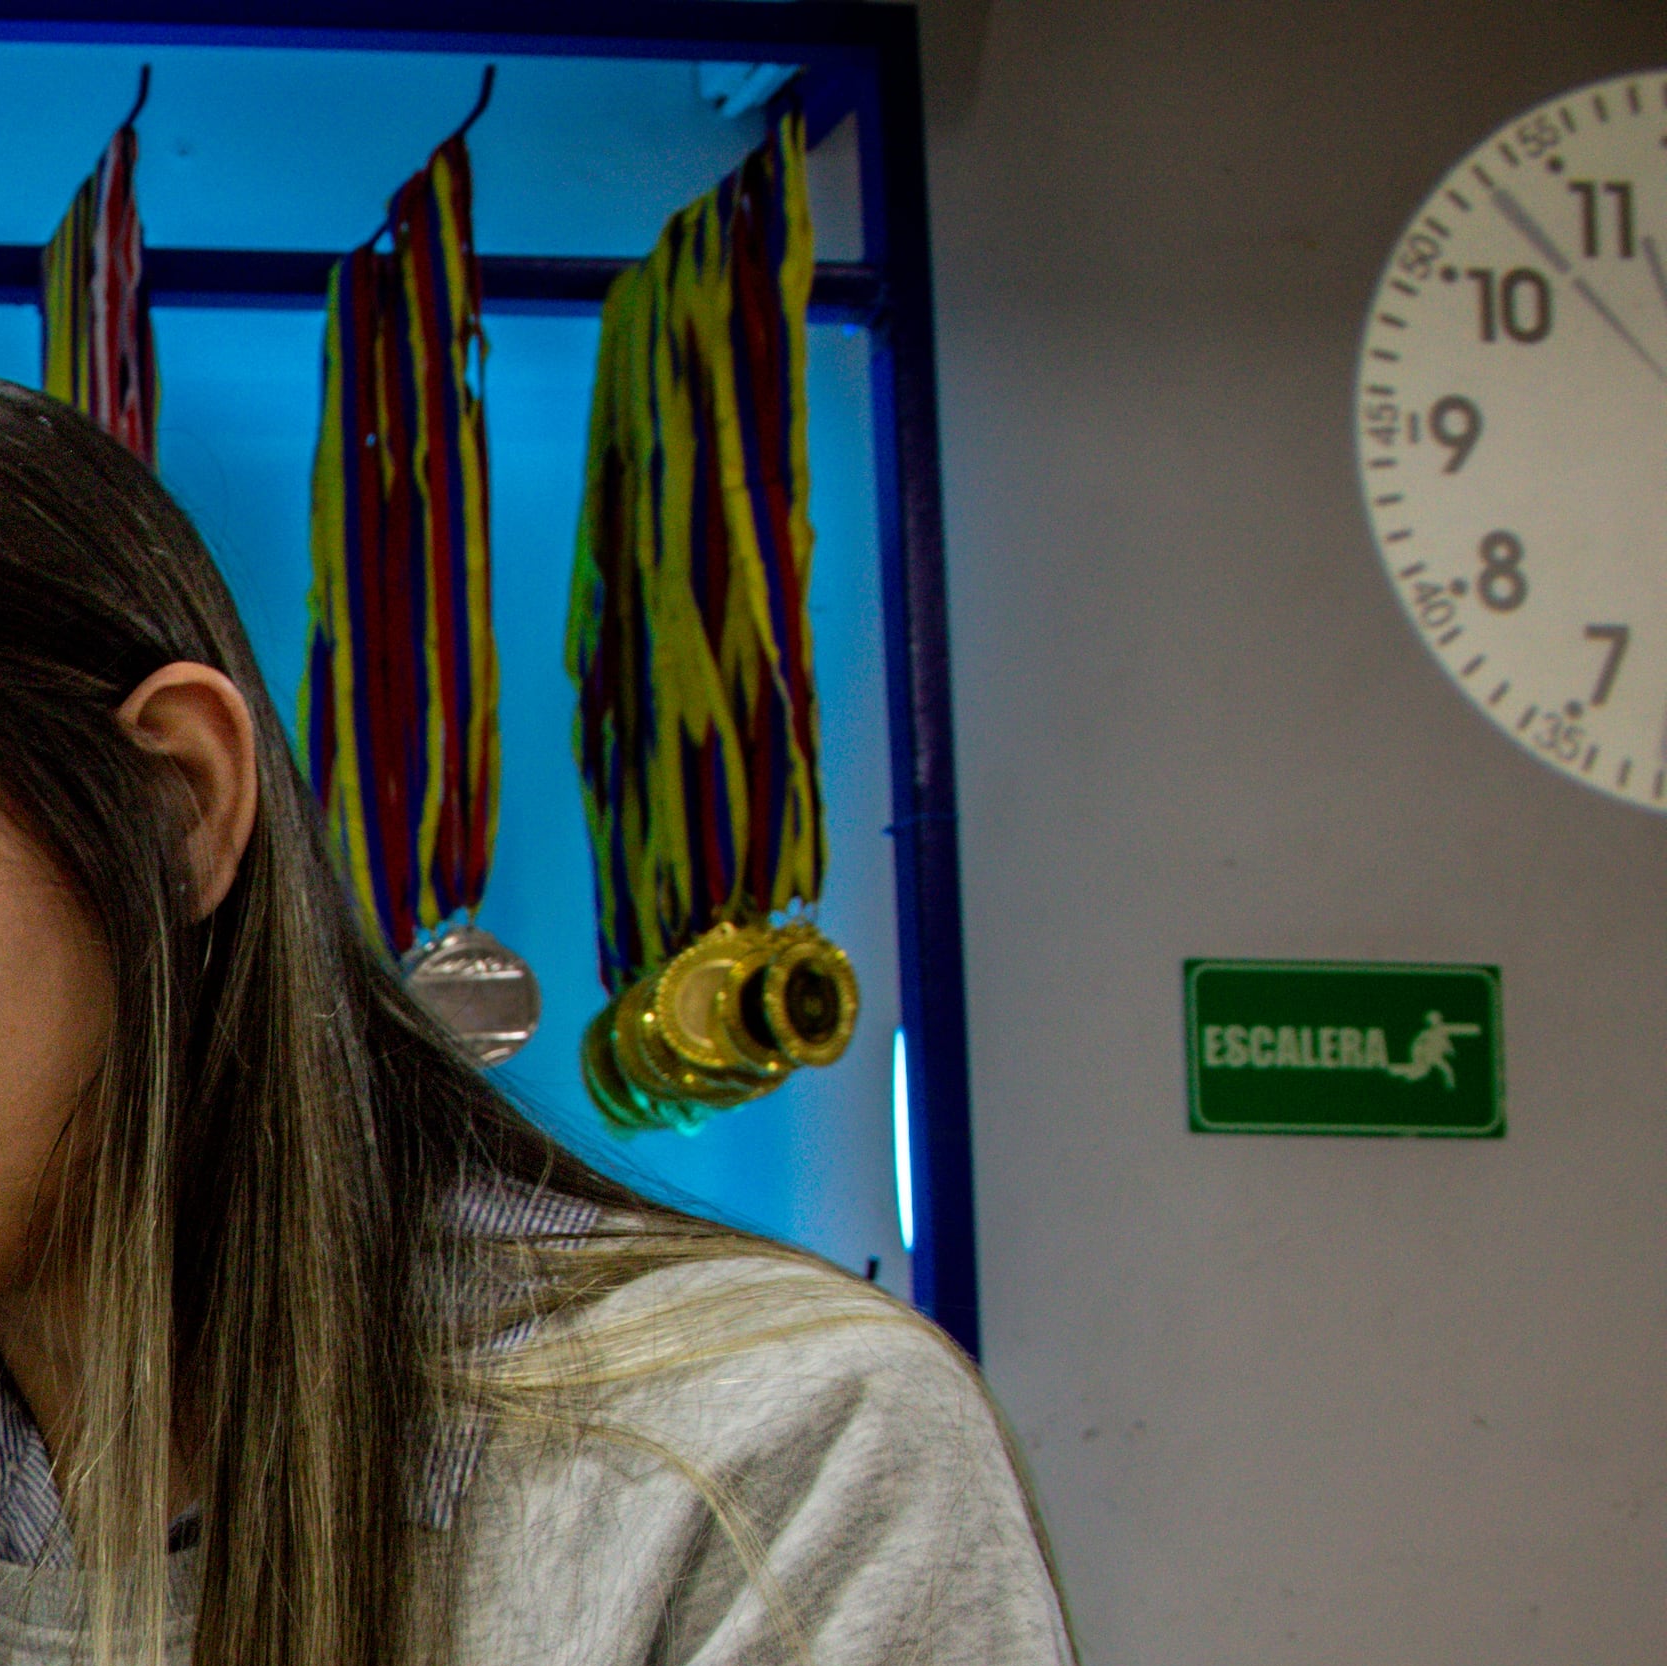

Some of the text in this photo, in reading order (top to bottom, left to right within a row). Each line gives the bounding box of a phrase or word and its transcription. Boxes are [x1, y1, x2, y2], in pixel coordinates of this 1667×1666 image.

[1517, 113, 1562, 159] 55
[1566, 179, 1634, 259] 11
[1398, 234, 1441, 282] 50
[1464, 266, 1553, 345] 10
[1366, 403, 1400, 446] 45
[1429, 394, 1483, 476] 9
[1476, 528, 1529, 614] 8
[1414, 580, 1456, 627] 40
[1584, 623, 1630, 706] 7
[1532, 711, 1585, 763] 35
[1204, 1024, 1389, 1069] ESCALERA
